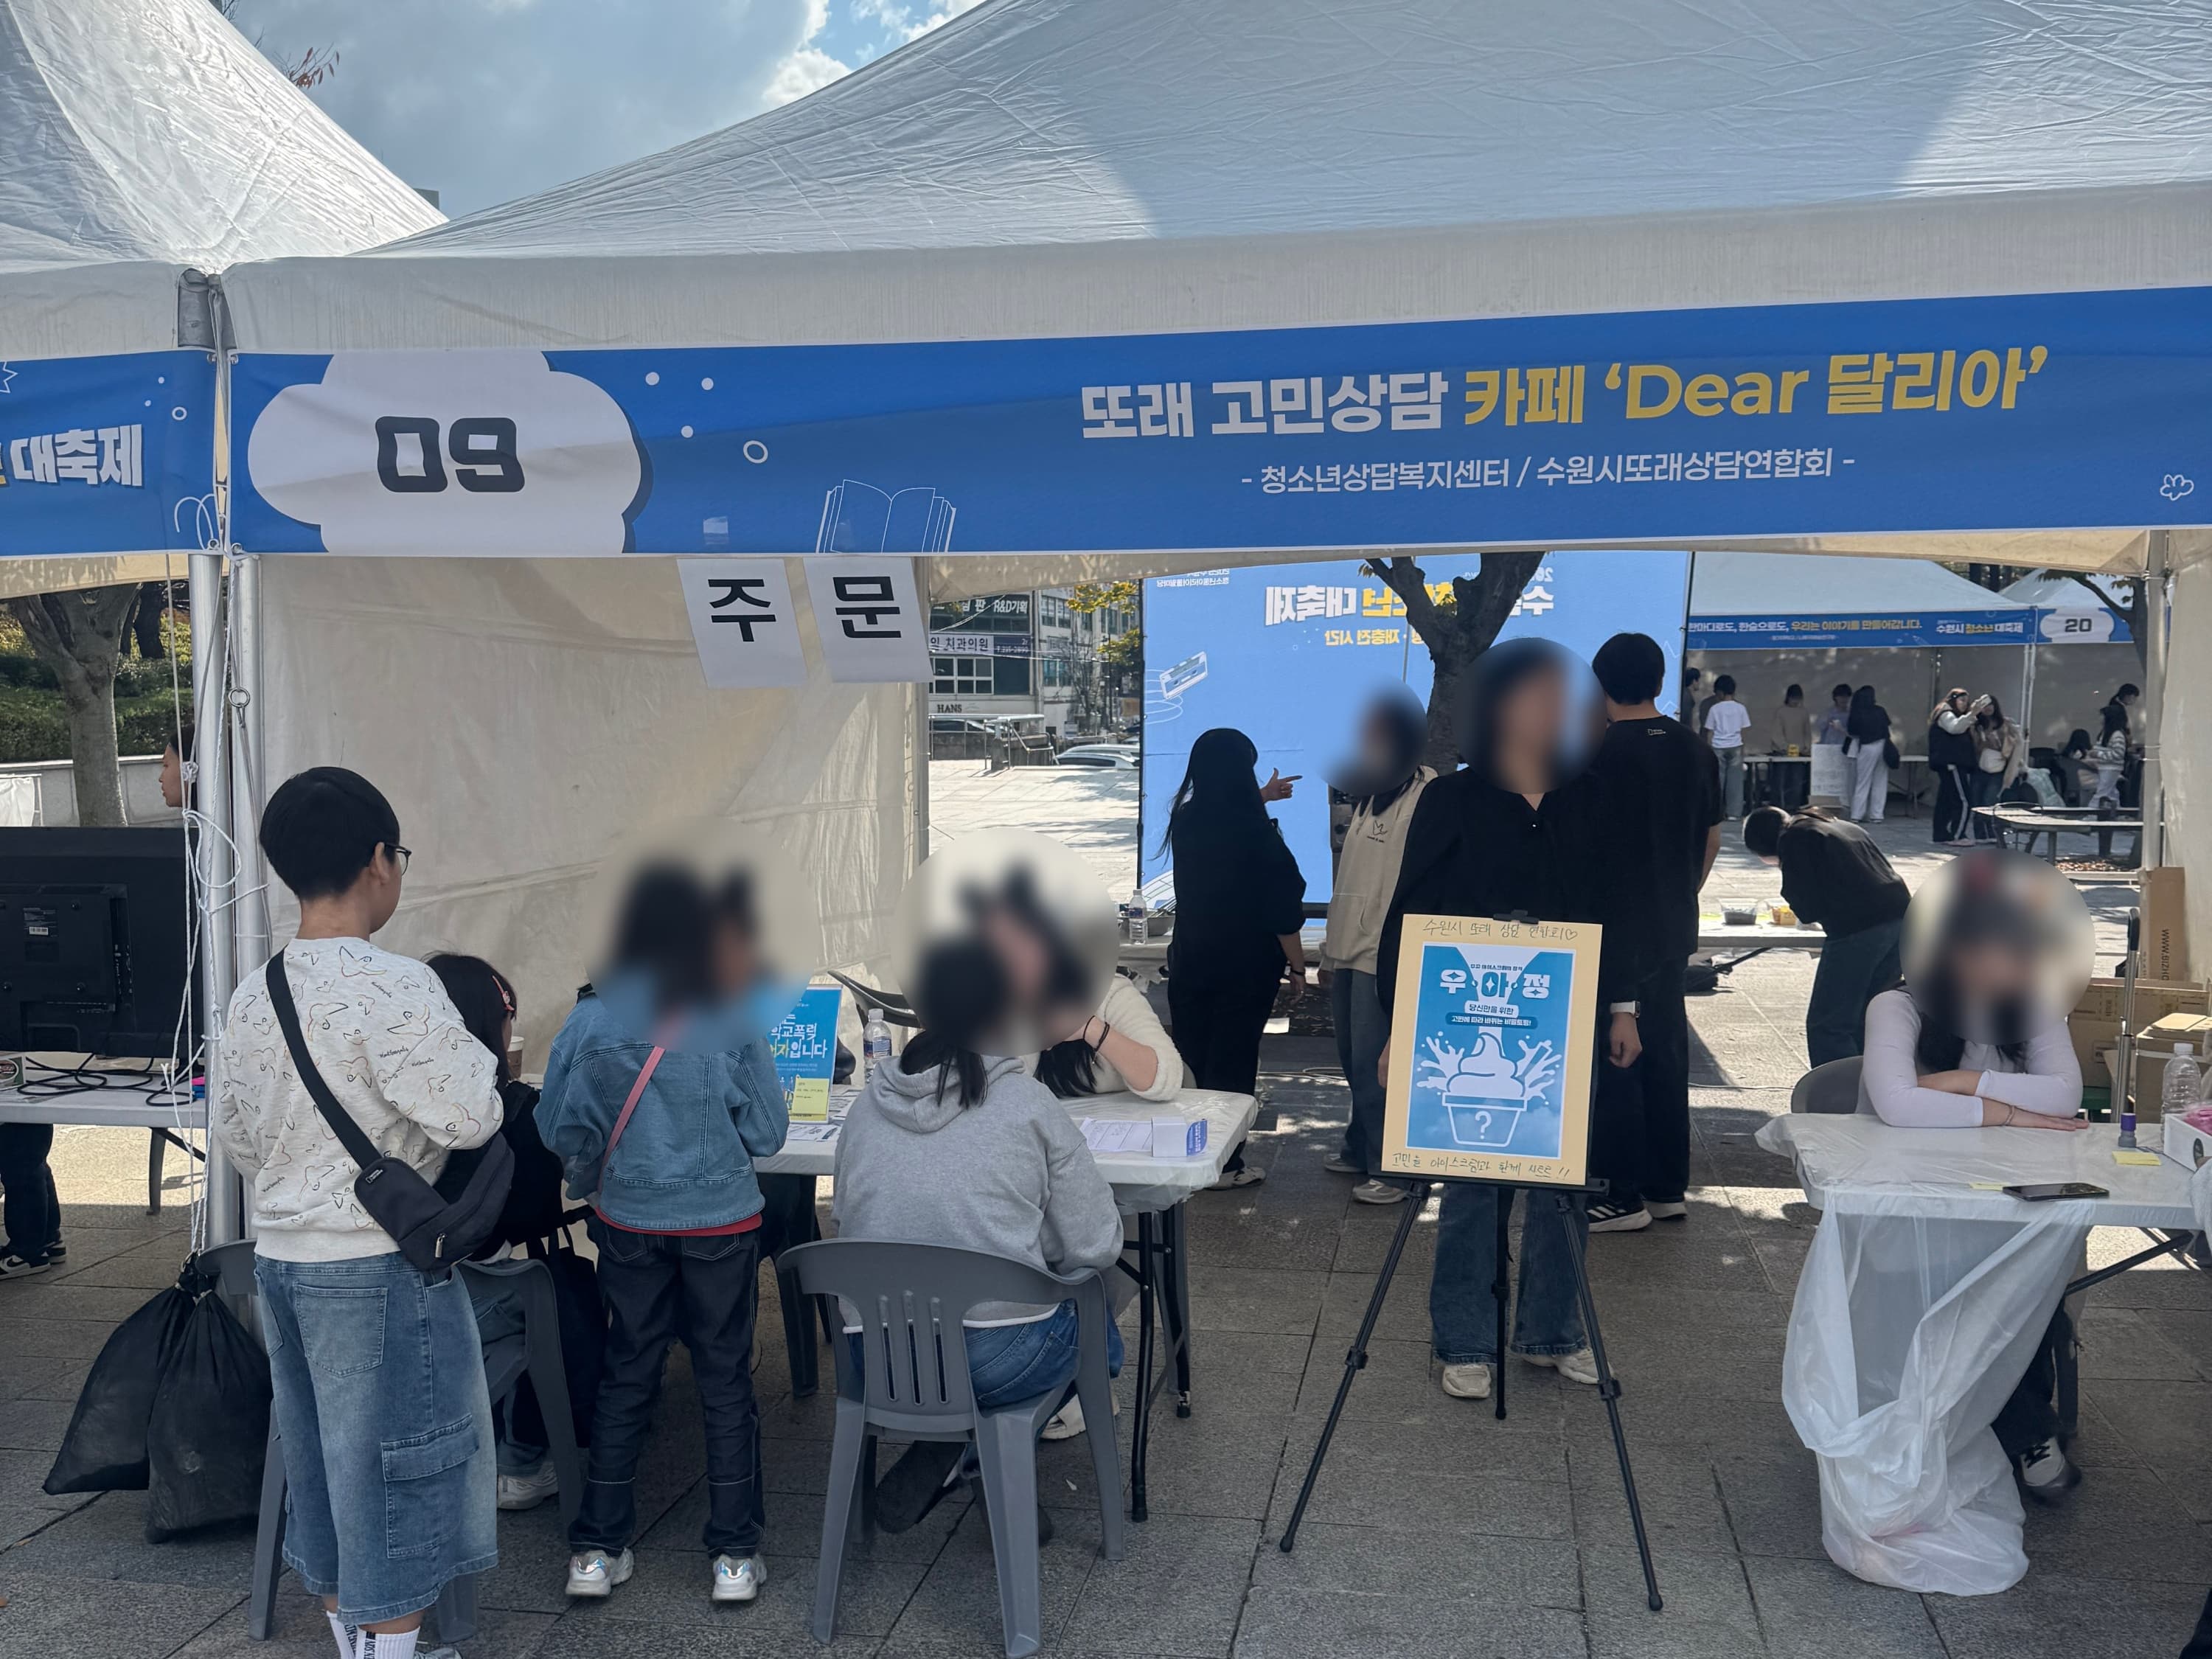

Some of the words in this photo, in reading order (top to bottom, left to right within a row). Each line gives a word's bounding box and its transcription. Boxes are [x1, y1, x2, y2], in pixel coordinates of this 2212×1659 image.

[1082, 382, 1195, 439] 또래
[1211, 370, 1450, 435] 고민상담
[1464, 365, 1586, 426] 카페
[10, 423, 143, 487] 대축제
[375, 415, 526, 493] 09
[1262, 458, 1510, 494] 청소년상담복지센터
[1537, 447, 1833, 487] 수원시또래상담연합회
[707, 577, 777, 643] 주
[832, 575, 902, 639] 문
[1791, 621, 1820, 632] 우리는
[2065, 618, 2093, 633] 20
[937, 703, 962, 714] HANS
[1422, 919, 1462, 936] 수원시
